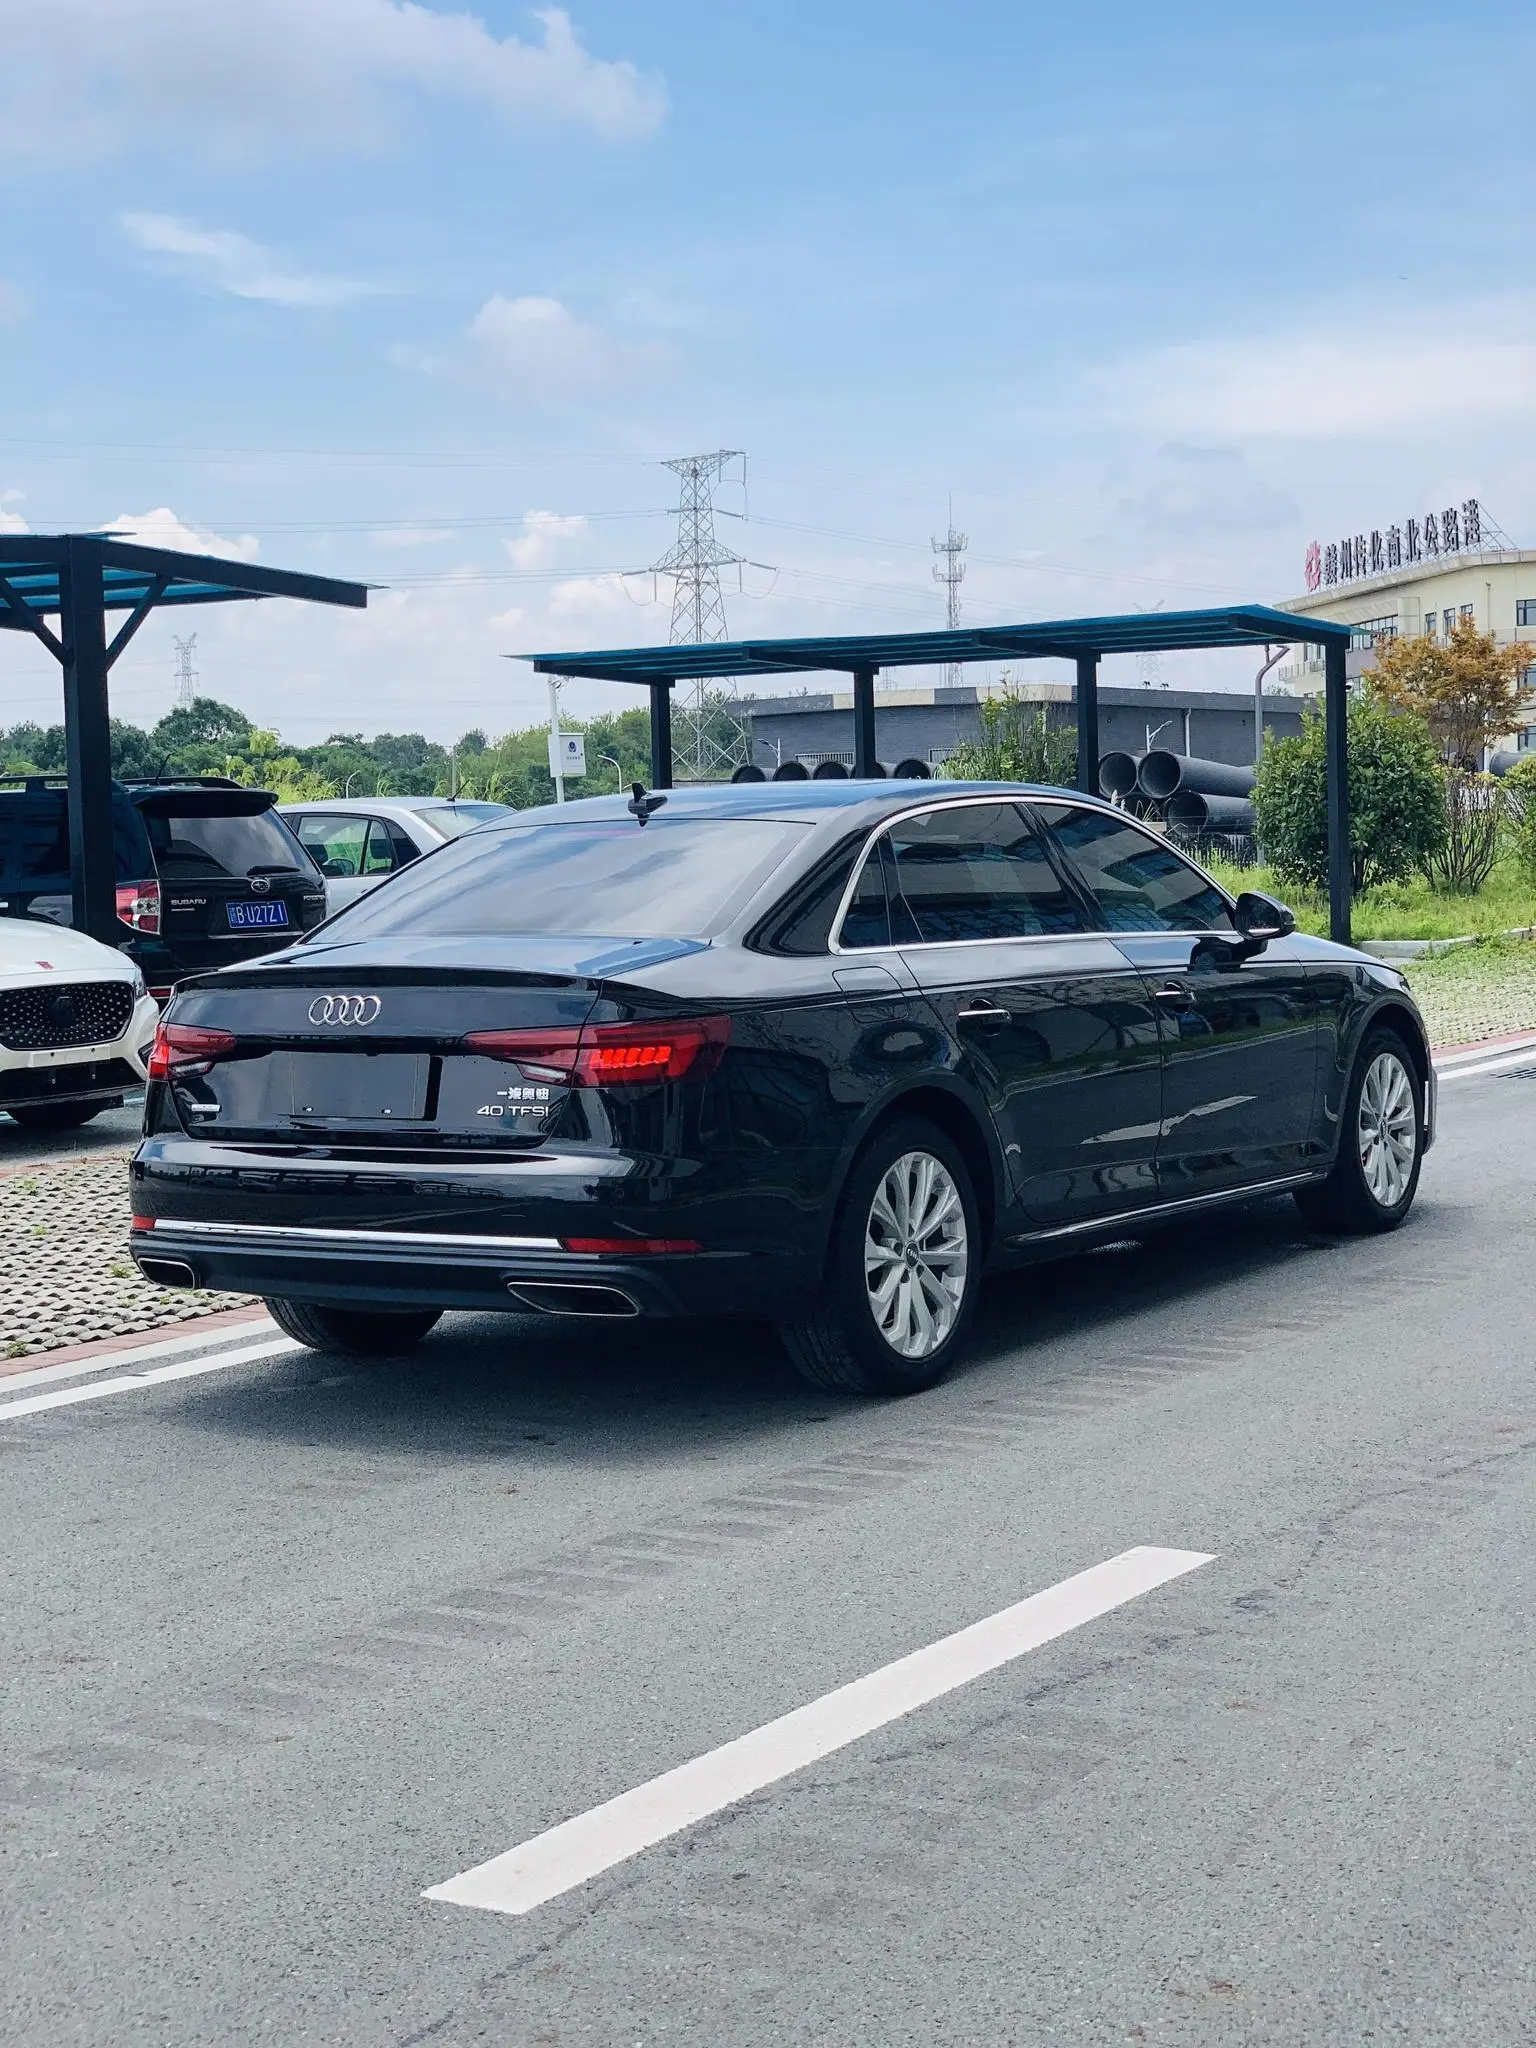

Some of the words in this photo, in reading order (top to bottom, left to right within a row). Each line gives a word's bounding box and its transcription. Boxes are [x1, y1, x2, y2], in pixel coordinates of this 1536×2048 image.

[171, 898, 207, 906] SUBARU
[497, 1087, 549, 1100] 一汽奥迪
[477, 1105, 504, 1116] 40
[508, 1105, 549, 1117] TFSI
